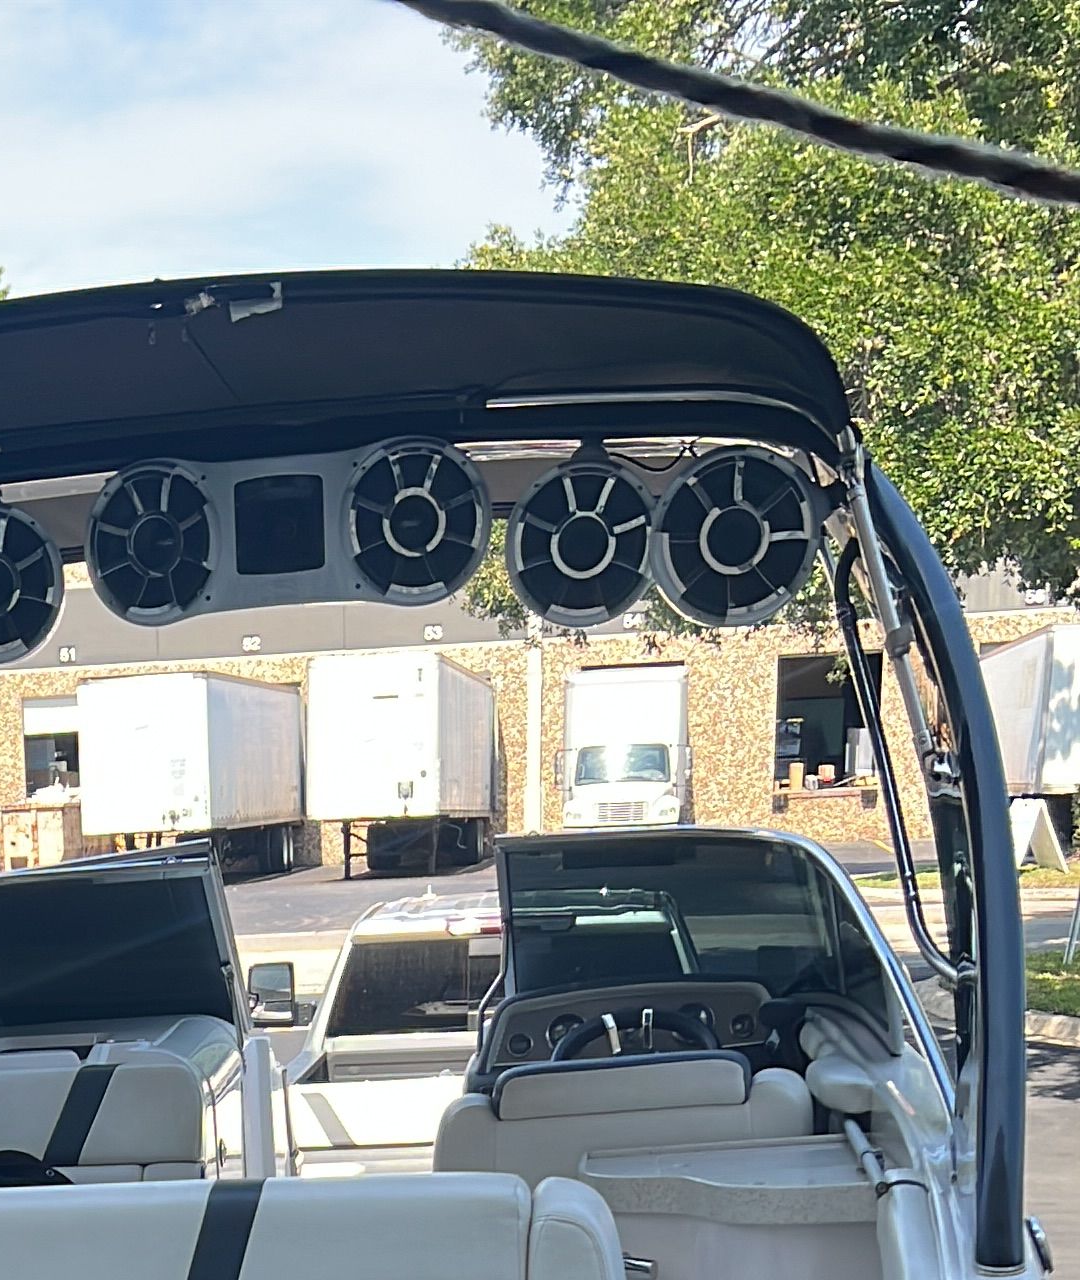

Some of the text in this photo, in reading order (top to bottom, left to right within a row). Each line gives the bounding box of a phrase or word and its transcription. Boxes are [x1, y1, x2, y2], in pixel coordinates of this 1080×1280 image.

[423, 625, 443, 640] 53
[242, 636, 261, 651] 52
[59, 647, 76, 662] 51
